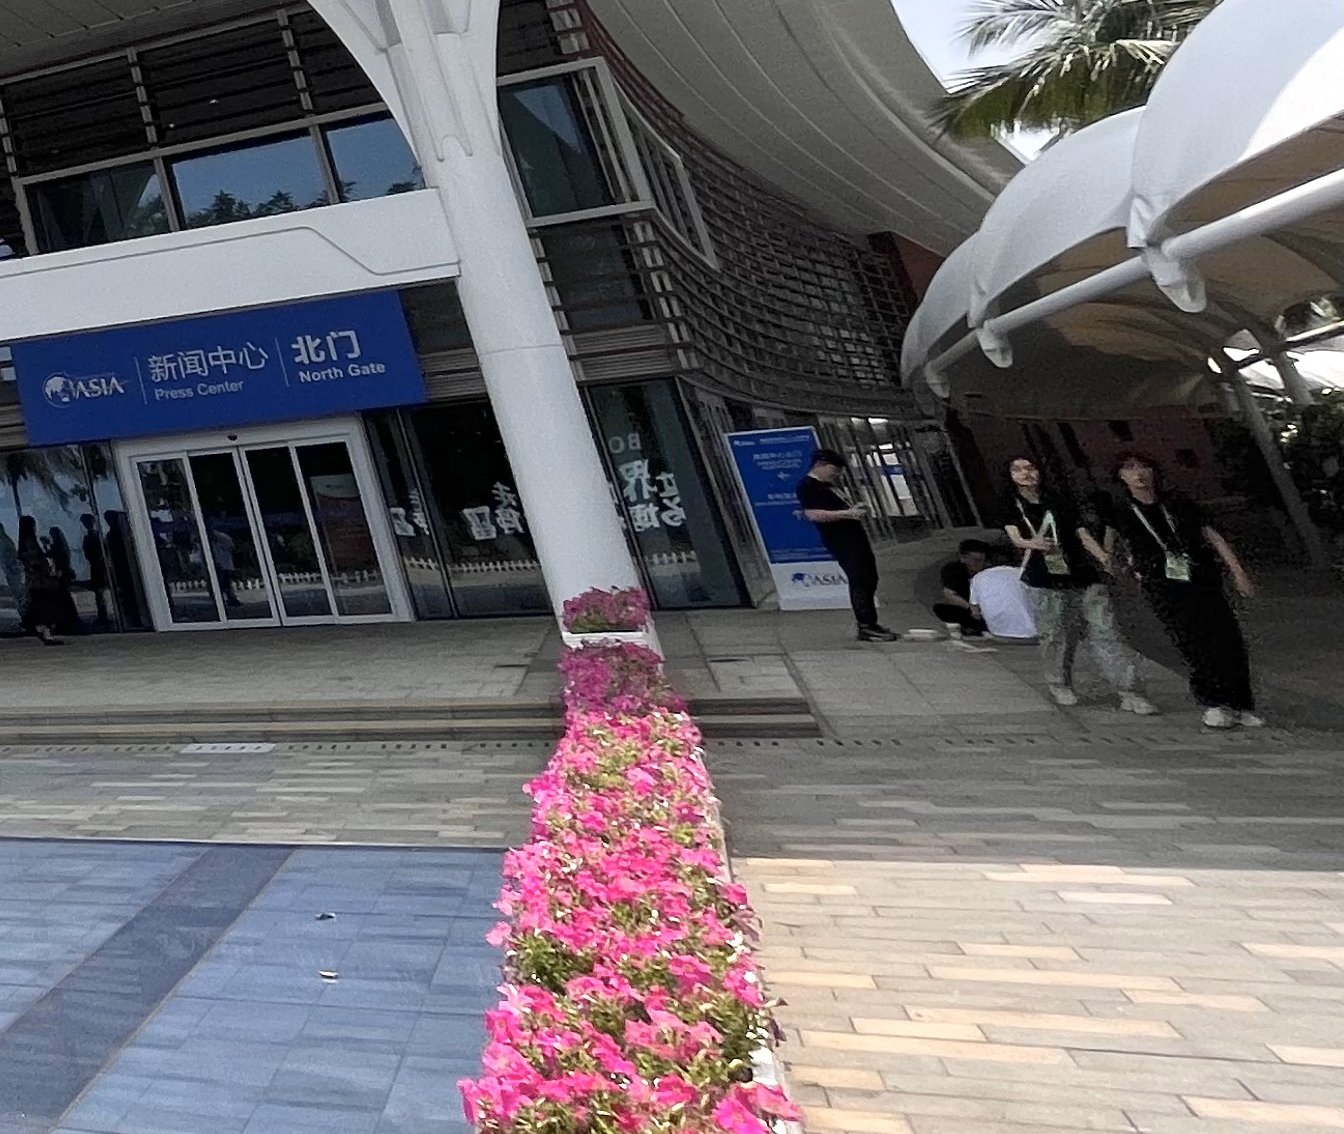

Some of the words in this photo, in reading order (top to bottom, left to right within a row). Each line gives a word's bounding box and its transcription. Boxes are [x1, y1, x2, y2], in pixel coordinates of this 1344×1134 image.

[291, 329, 362, 365] 北门
[148, 341, 269, 383] 新闻中心
[298, 366, 344, 384] North
[346, 361, 387, 379] Gate
[154, 384, 194, 402] Press
[196, 379, 245, 398] Center
